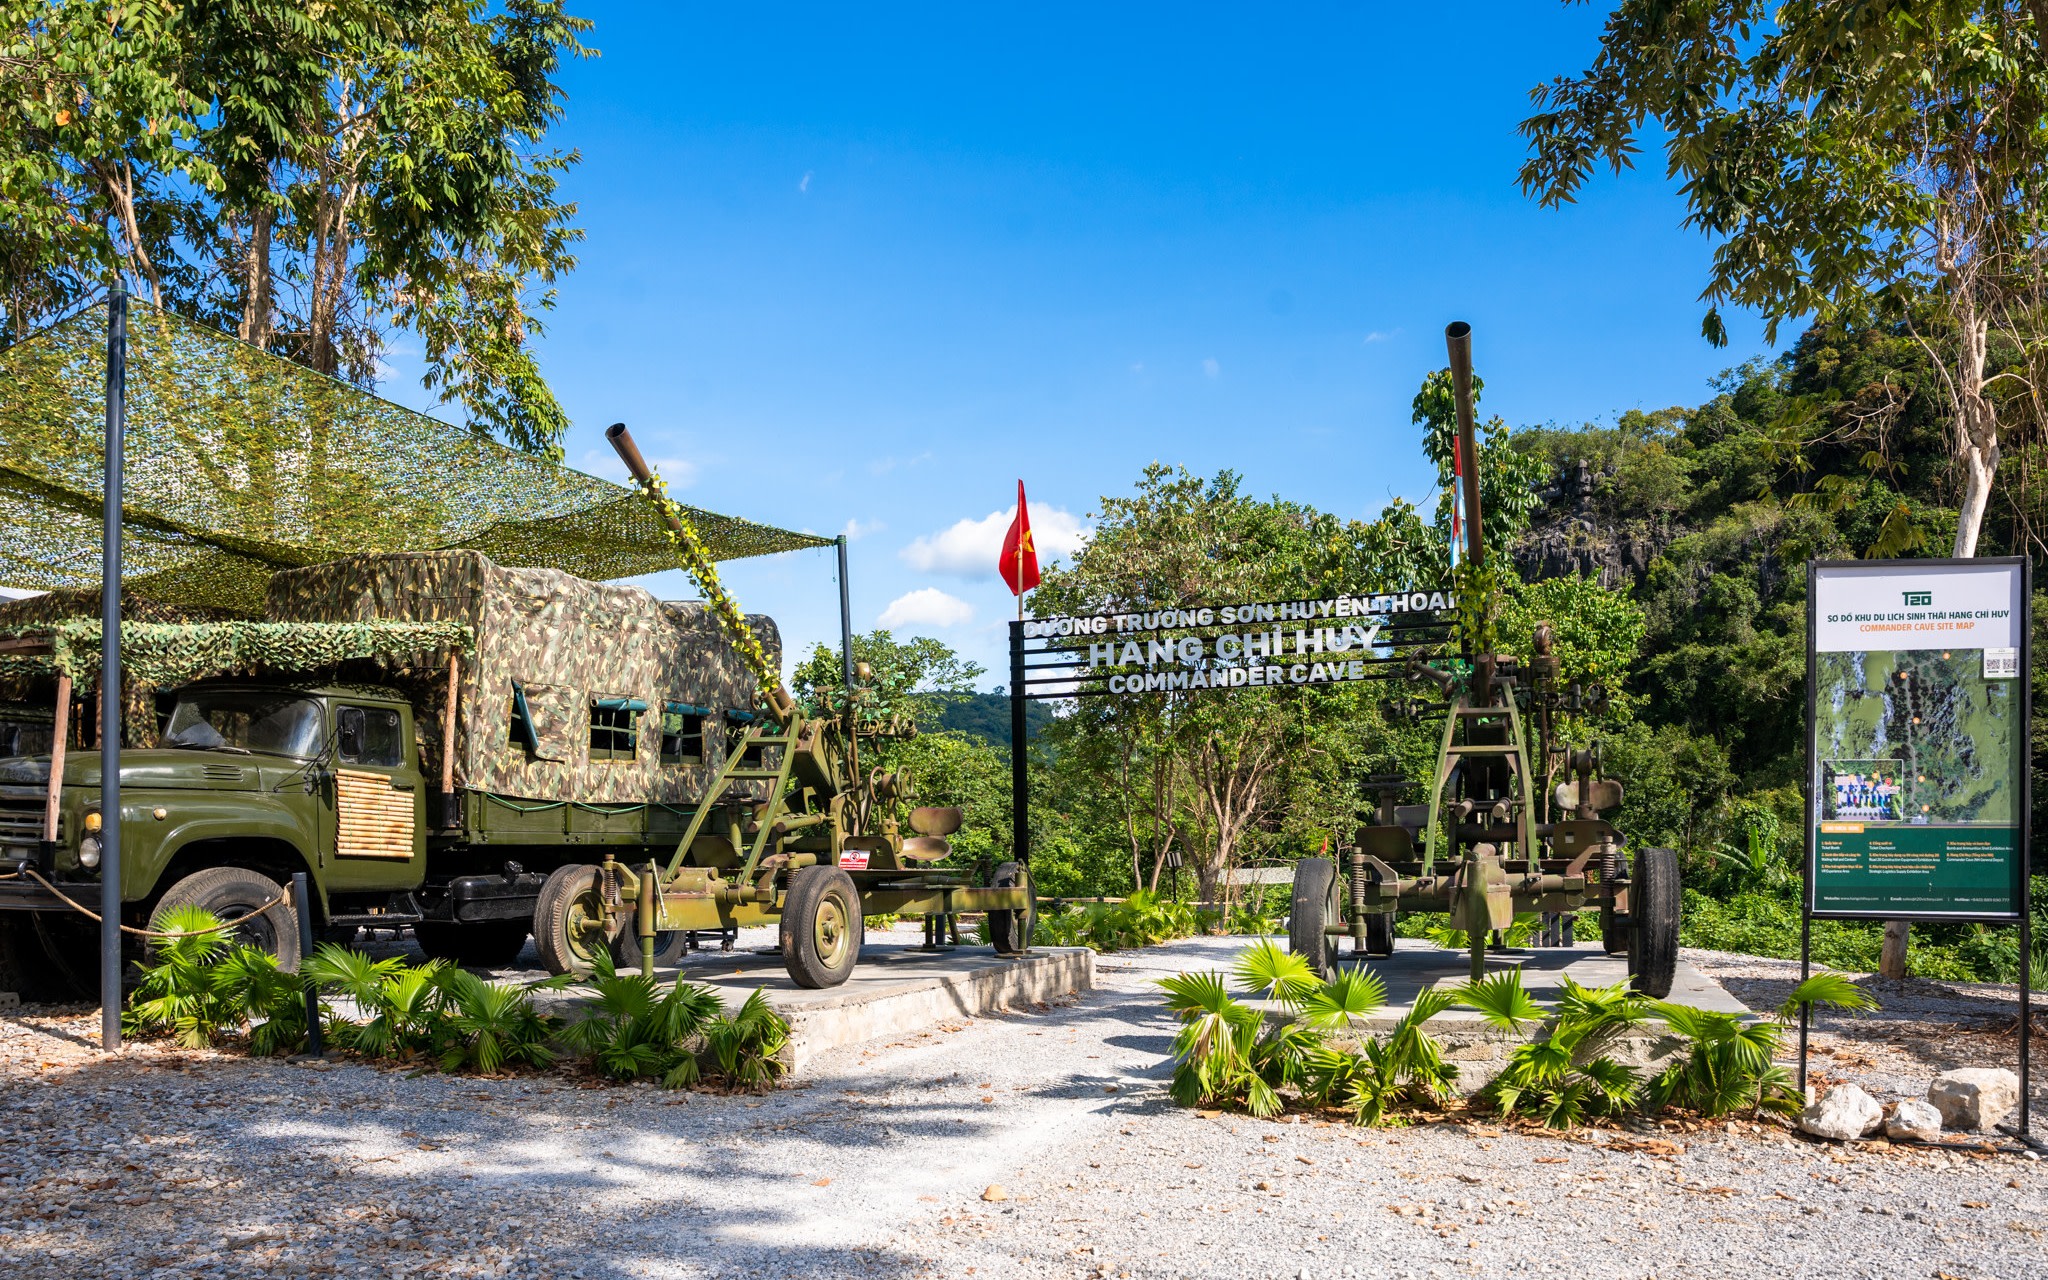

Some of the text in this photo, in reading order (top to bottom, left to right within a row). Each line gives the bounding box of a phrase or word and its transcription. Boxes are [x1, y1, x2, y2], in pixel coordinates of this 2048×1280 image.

[1113, 606, 1214, 631] TRƯỜNG
[1220, 603, 1273, 624] SƠN
[1855, 613, 1872, 621] KHU
[1873, 613, 1886, 621] DU
[1887, 612, 1905, 623] LỊCH
[1906, 611, 1926, 620] SINH
[1928, 609, 1947, 620] THÁI
[1949, 611, 1972, 619] HANG
[1991, 609, 2009, 618] HUY
[1860, 621, 1975, 632] COMMANDER CAVE SITE MAP
[1089, 623, 1381, 668] HANG CHỈ HUY
[1108, 659, 1365, 694] COMMANDER CAVE
